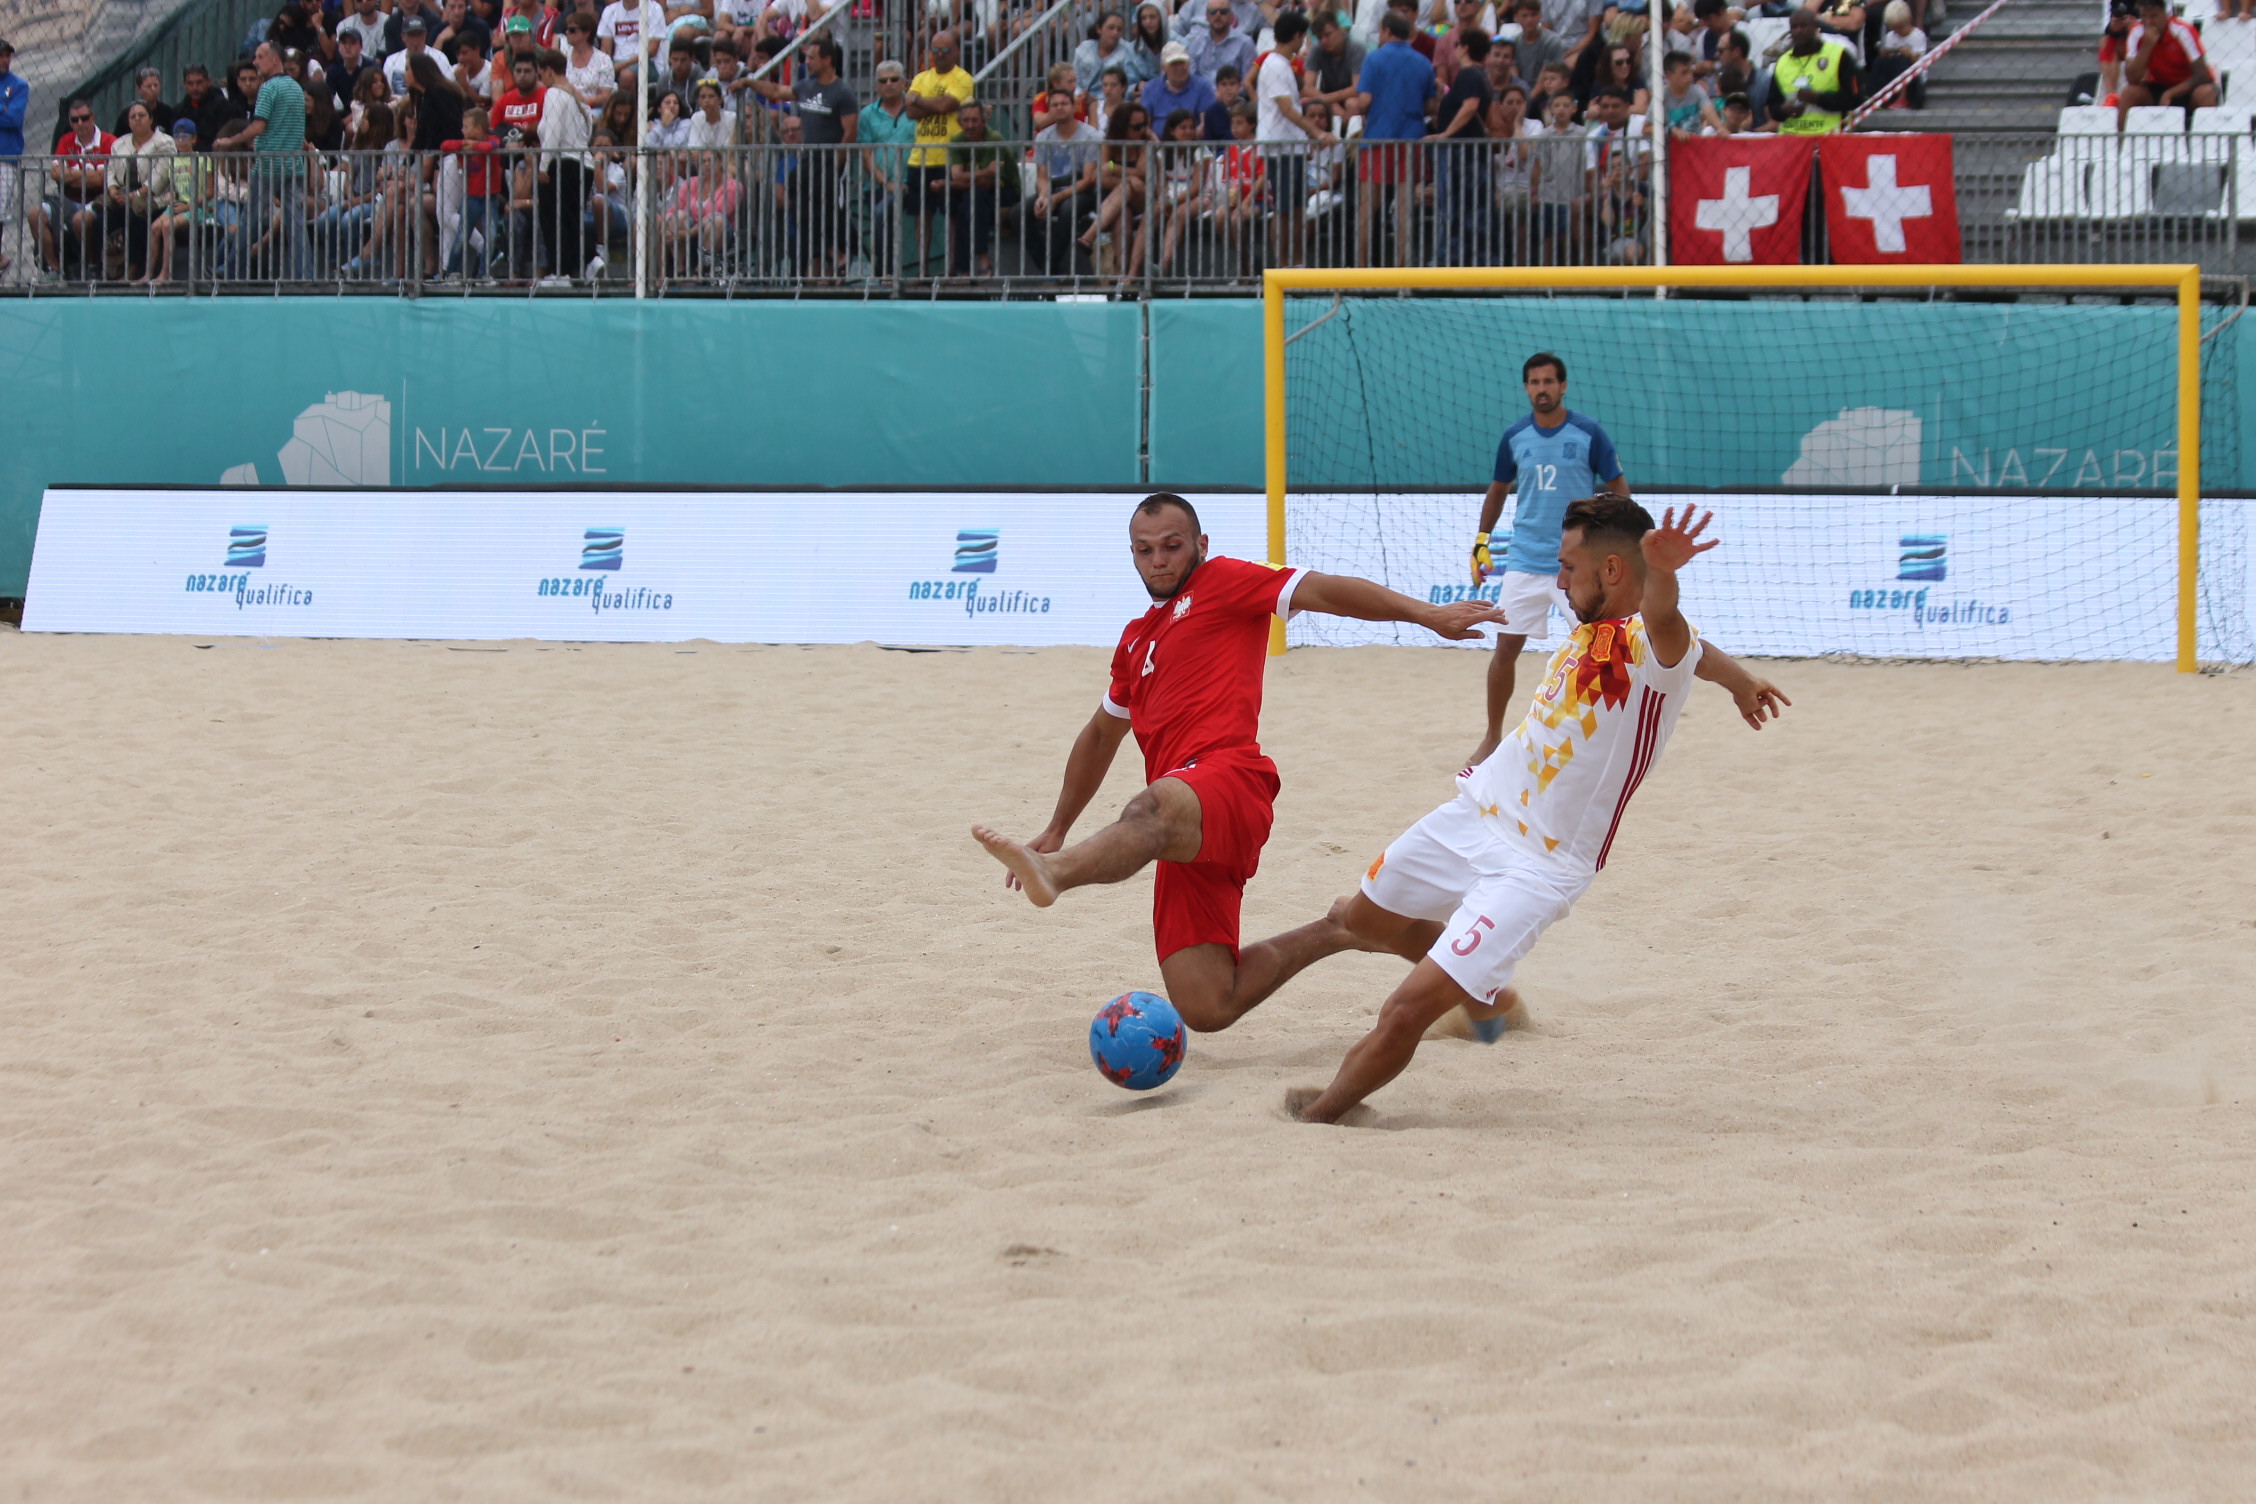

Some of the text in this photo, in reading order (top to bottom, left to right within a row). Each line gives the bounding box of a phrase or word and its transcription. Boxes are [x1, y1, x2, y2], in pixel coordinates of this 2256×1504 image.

[415, 419, 607, 472] NAZARÉ
[1535, 463, 1558, 490] 12
[185, 571, 251, 592] nazaré
[537, 574, 608, 596] nazaré
[909, 577, 981, 599] nazaré
[235, 583, 313, 610] qualifica
[591, 586, 673, 615] qualifica
[966, 590, 1050, 618] qualifica
[1850, 586, 1930, 609] nazaré
[1914, 599, 2010, 629] qualifica
[1543, 654, 1580, 703] 5
[1450, 914, 1496, 957] 5
